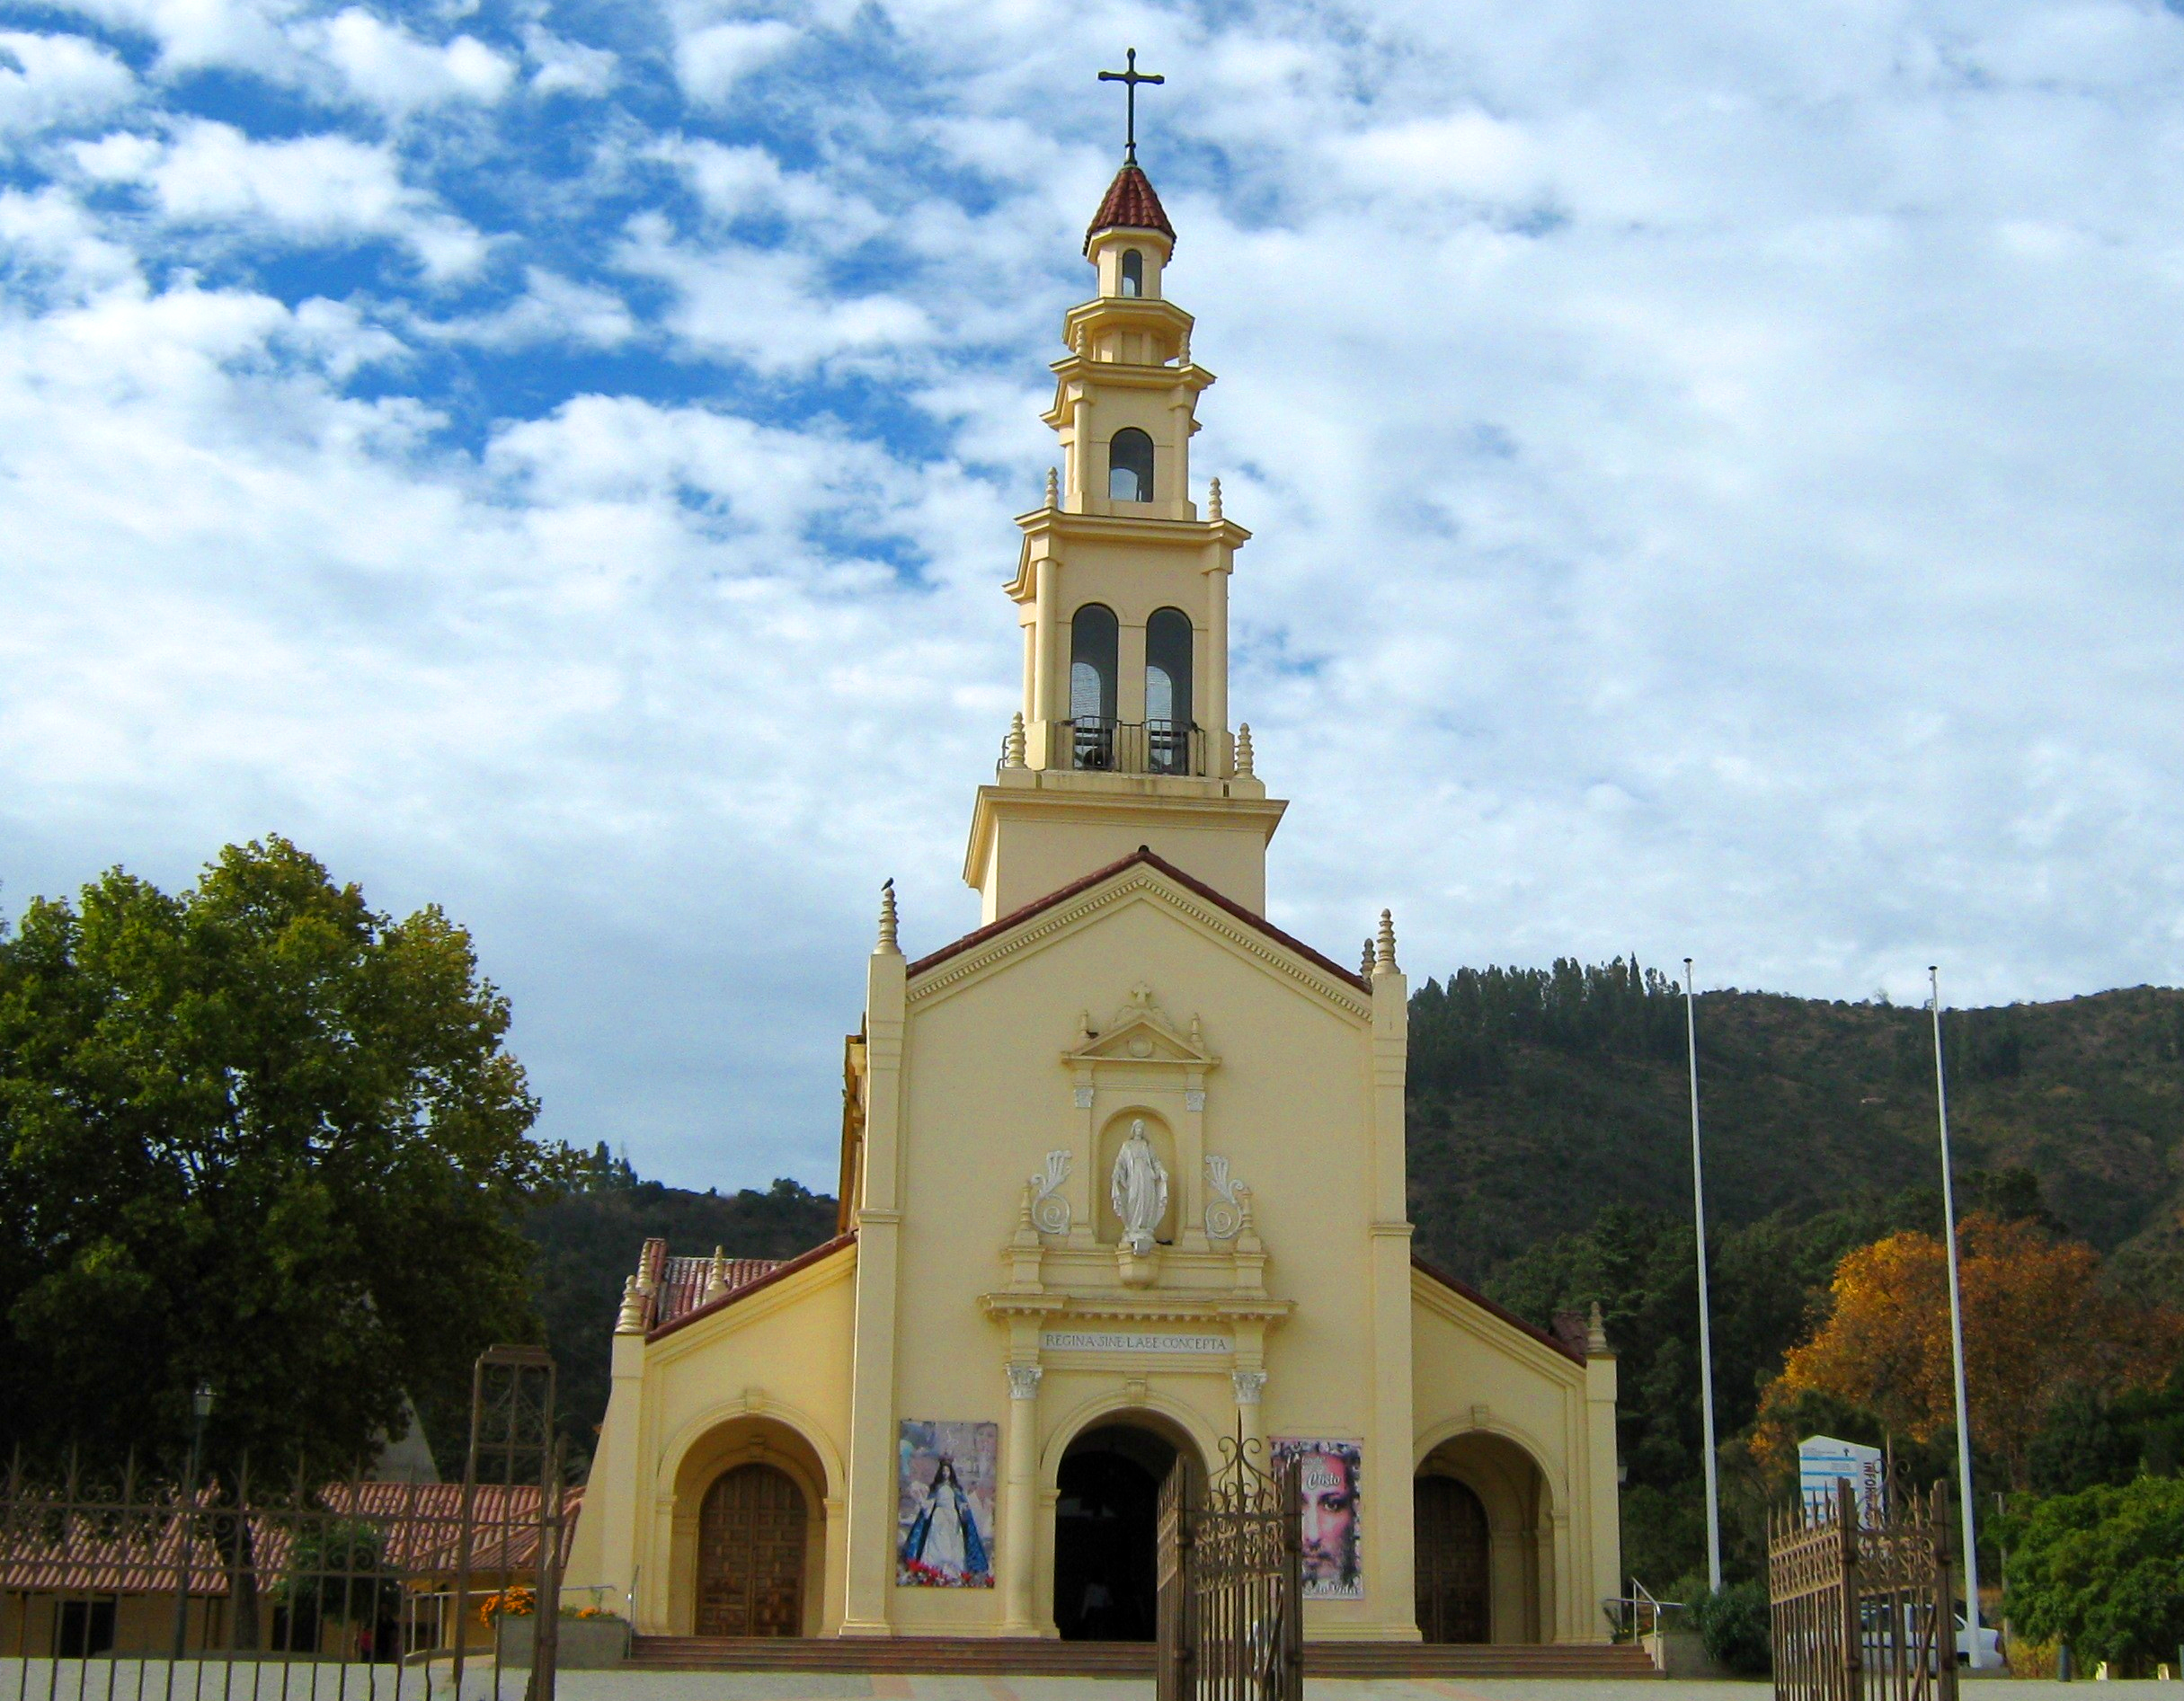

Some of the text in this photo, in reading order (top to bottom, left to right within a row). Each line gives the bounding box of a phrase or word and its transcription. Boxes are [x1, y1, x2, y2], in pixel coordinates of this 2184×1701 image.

[1046, 1334, 1226, 1351] REGINA SINE LABE CONCEPTA
